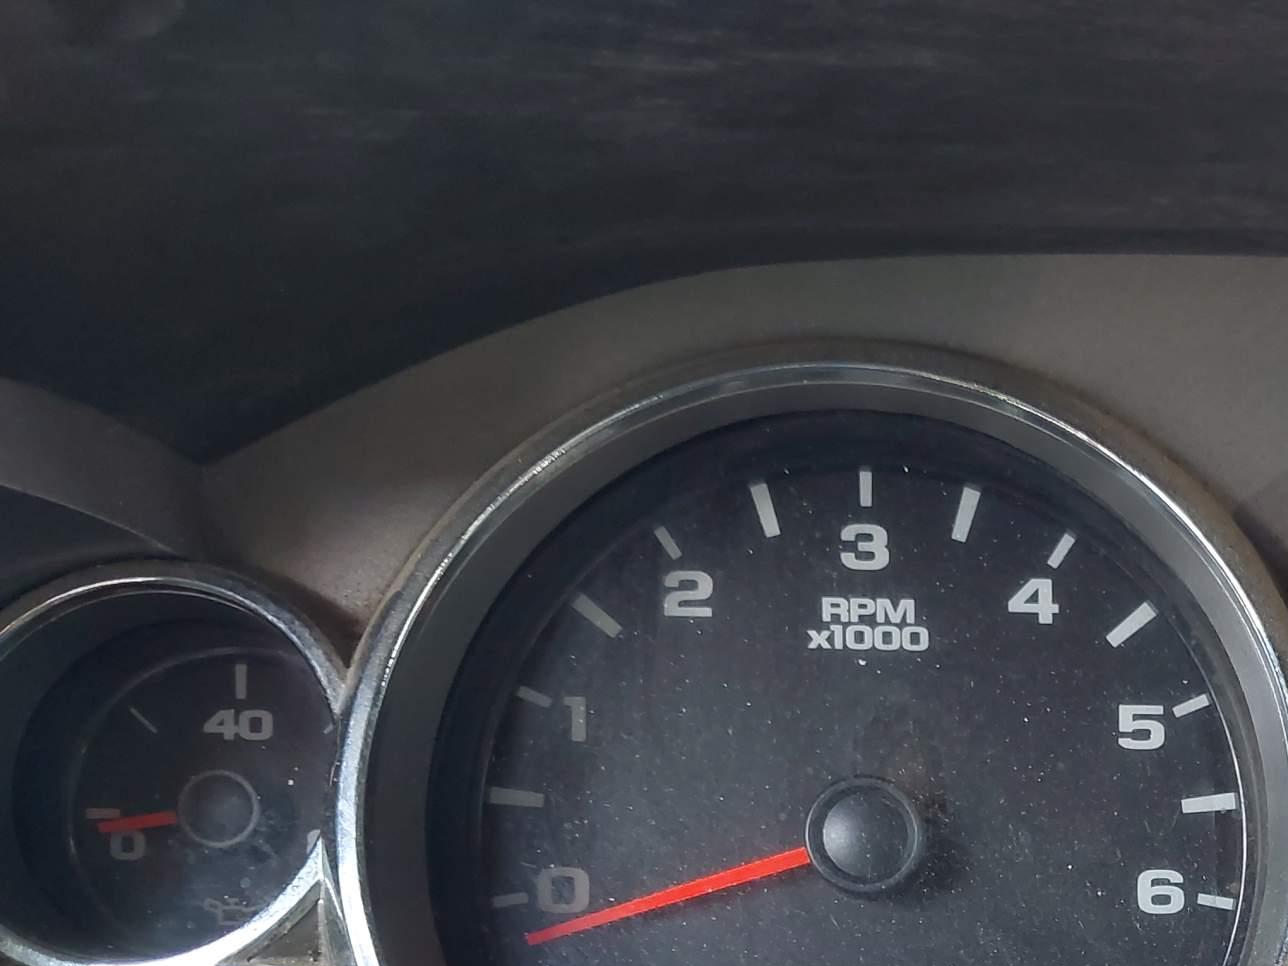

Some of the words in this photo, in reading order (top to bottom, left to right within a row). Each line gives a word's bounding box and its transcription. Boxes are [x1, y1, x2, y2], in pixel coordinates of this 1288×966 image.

[840, 525, 890, 571] 3
[663, 571, 713, 618] 2
[822, 598, 915, 623] RPM
[1008, 578, 1059, 624] 4
[807, 624, 929, 652] x1000
[202, 708, 273, 741] 40
[563, 697, 585, 743] 1
[1118, 705, 1164, 750] 5
[110, 830, 146, 861] 0
[539, 867, 589, 913] 0
[1137, 871, 1184, 915] 6
